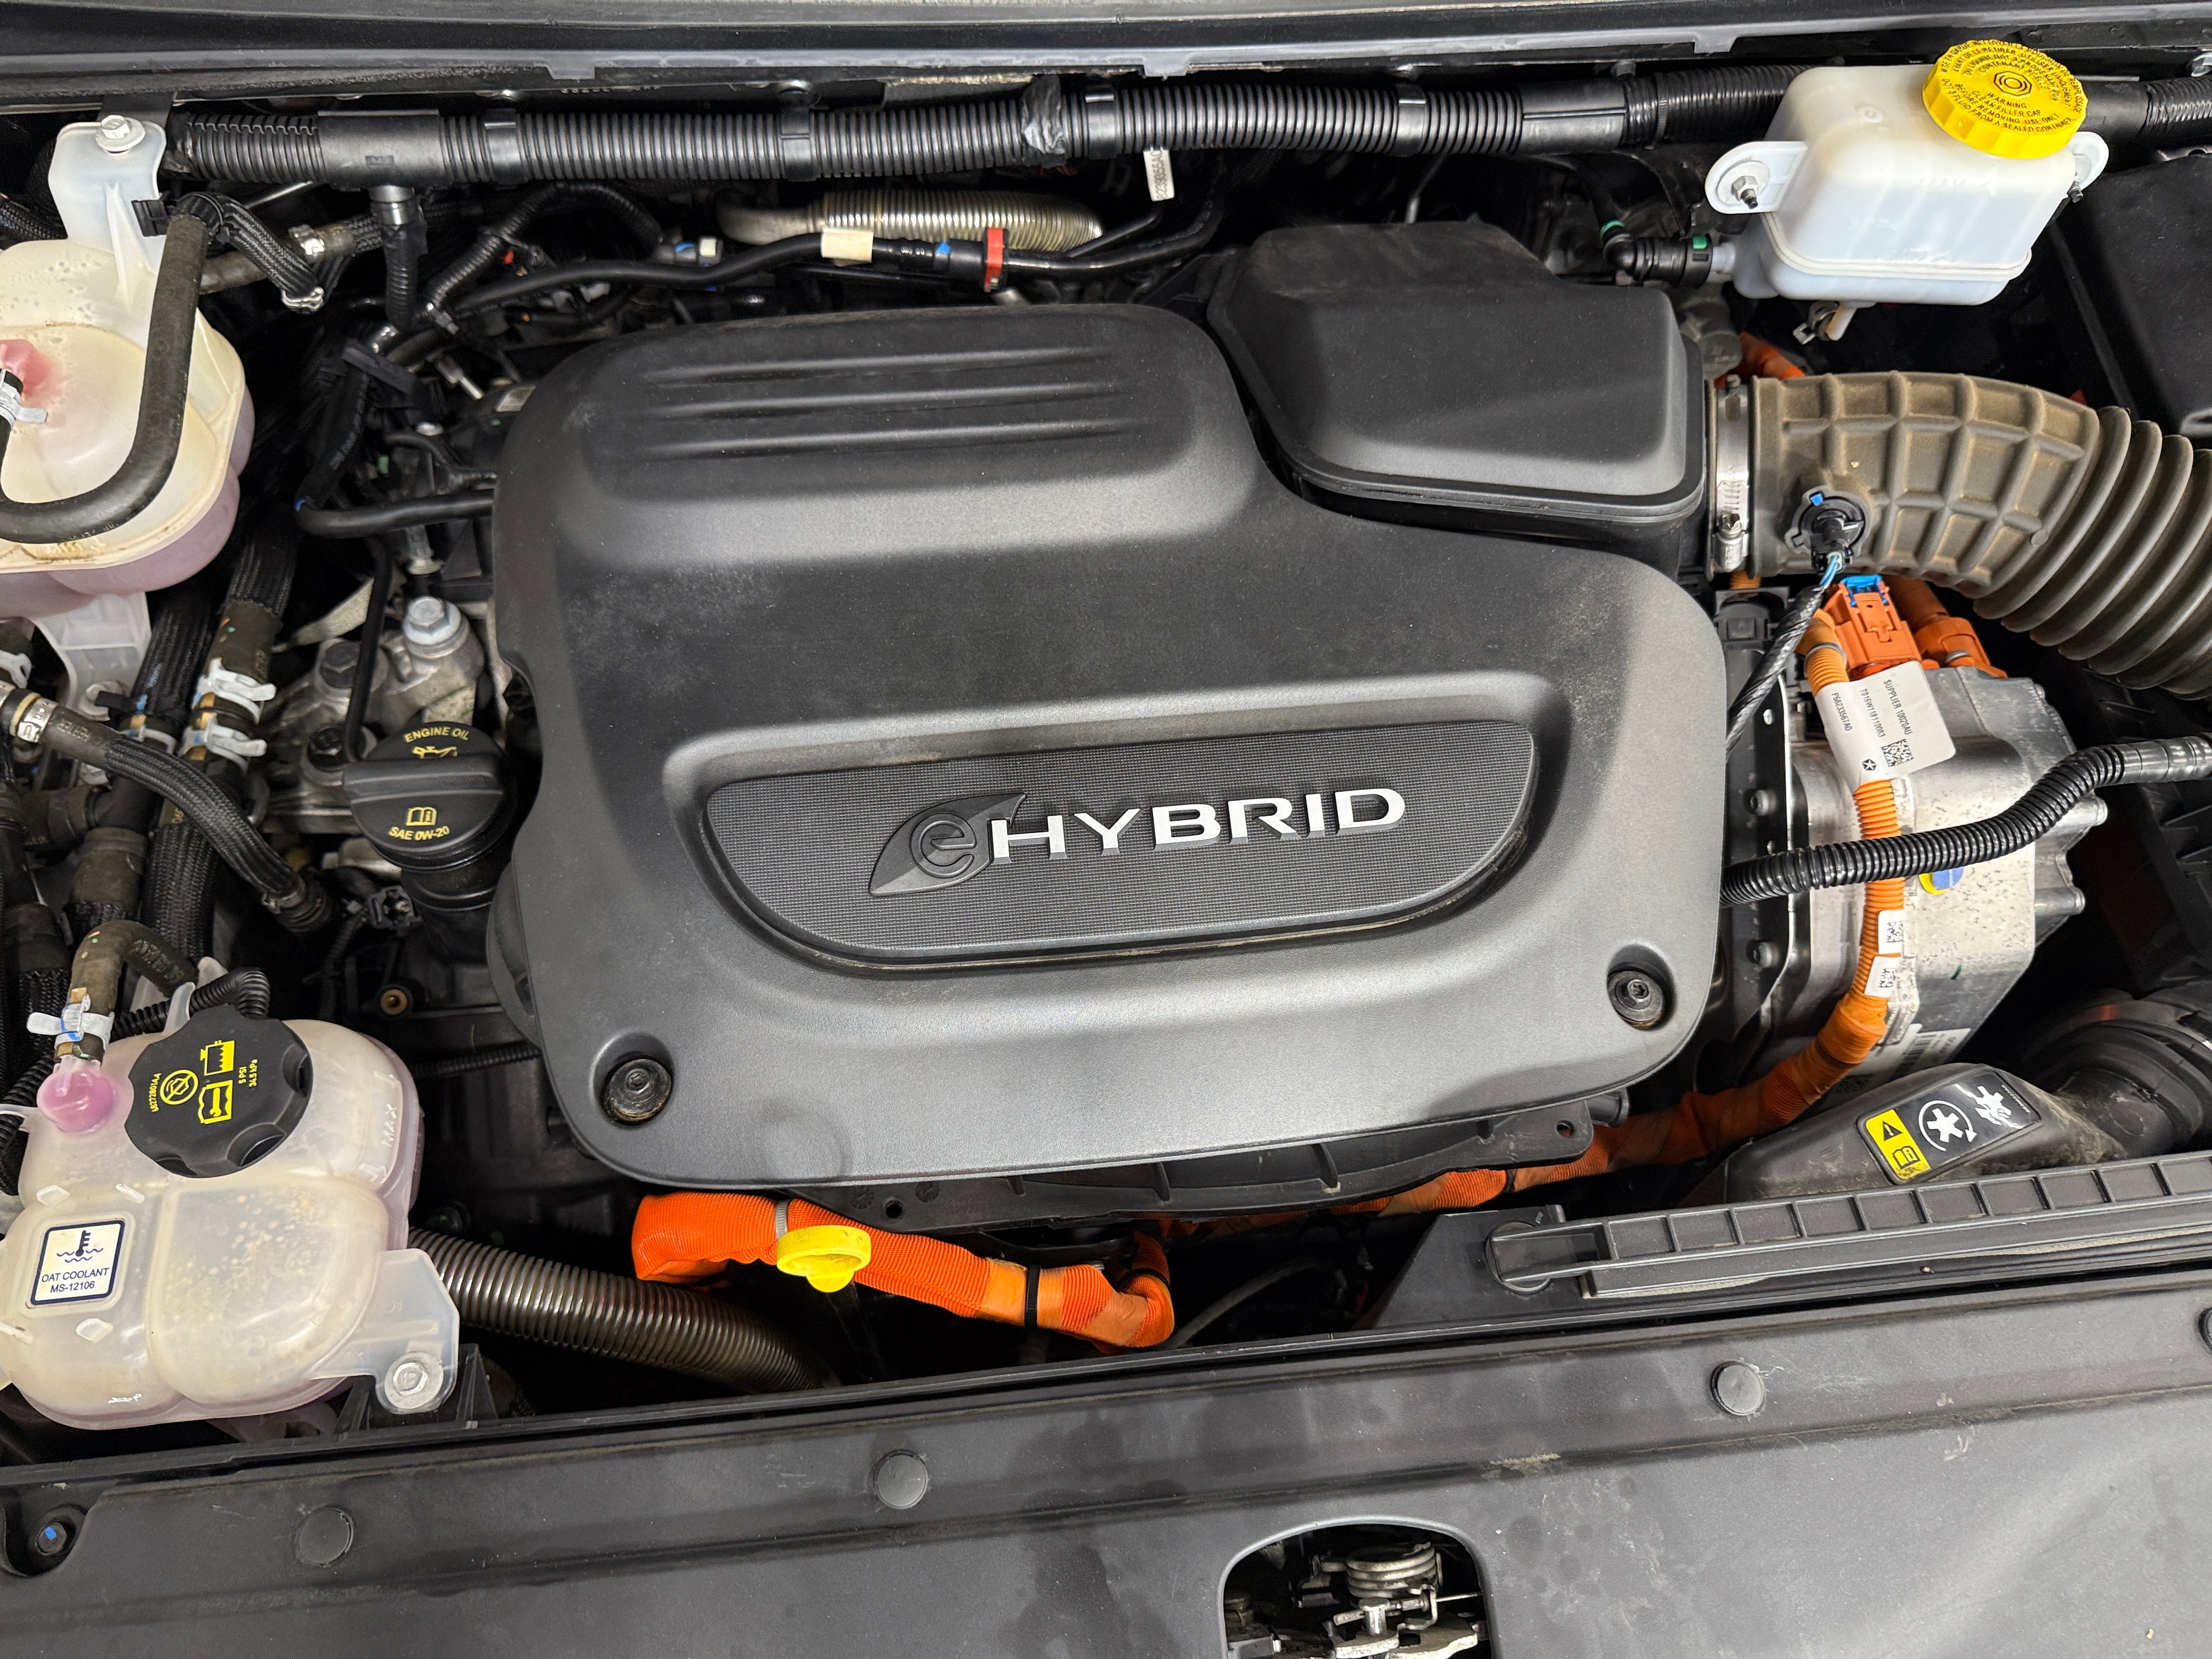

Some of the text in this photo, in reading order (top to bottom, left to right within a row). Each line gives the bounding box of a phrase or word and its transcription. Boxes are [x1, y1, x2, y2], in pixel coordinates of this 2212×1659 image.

[1953, 57, 1966, 72] AVANT
[1955, 84, 1978, 105] BEFORE
[2041, 112, 2060, 123] ONLY
[1971, 91, 2041, 117] CLEAN FILLER CAP
[1987, 92, 2027, 109] WARNING
[1951, 94, 1972, 110] FLUID
[1970, 109, 1994, 123] FROM
[2004, 123, 2034, 132] SEALED
[2035, 116, 2073, 132] CONTAINER
[1883, 679, 1913, 735] SUPPLIER 10020AU
[404, 726, 470, 743] ENGINE OIL
[388, 825, 450, 840] SAE 0W-20
[238, 1066, 247, 1079] PSI
[249, 1072, 257, 1087] 34.5
[41, 1267, 110, 1283] OAT COOLANT
[50, 1280, 95, 1294] MS-12106
